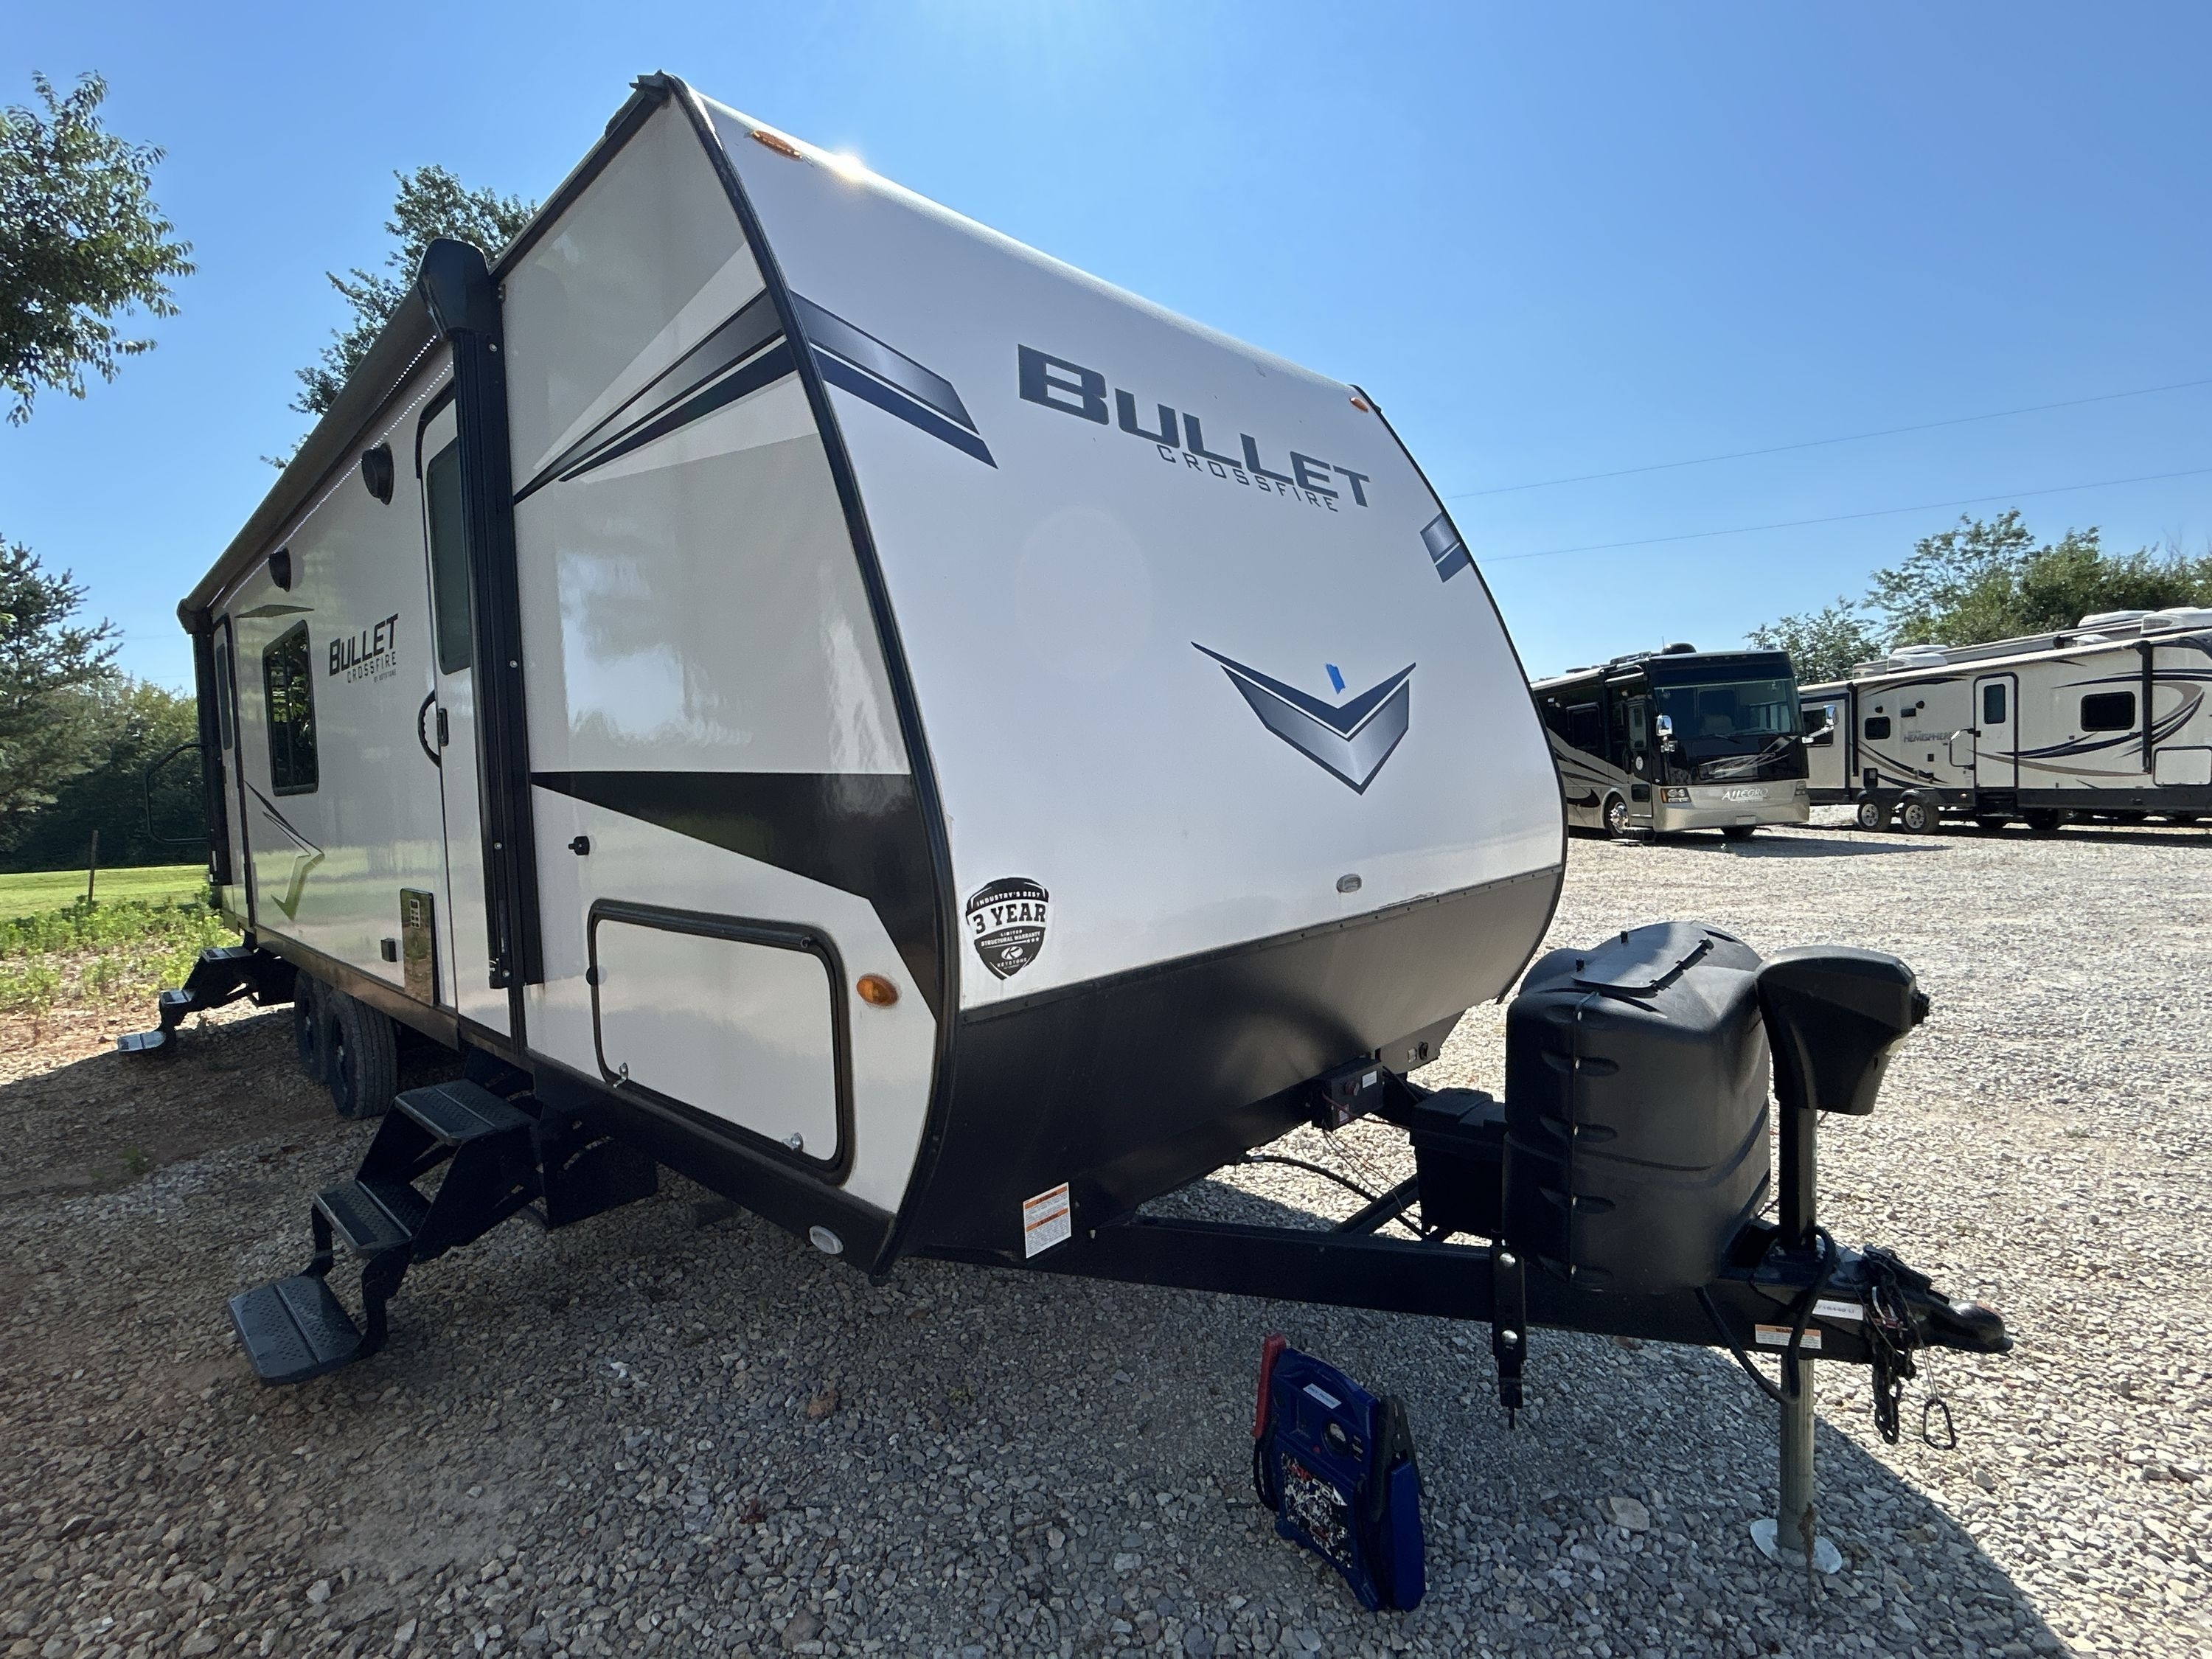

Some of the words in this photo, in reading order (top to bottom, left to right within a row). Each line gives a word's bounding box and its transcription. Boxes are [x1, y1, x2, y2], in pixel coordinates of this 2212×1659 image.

[1018, 344, 1371, 508] BULLET
[1155, 444, 1339, 512] CROSSFIRE
[329, 612, 399, 677] BULLET
[347, 650, 397, 684] CROSSFIRE
[976, 891, 1020, 907] INDUSTRY'S
[973, 913, 987, 935] 3
[990, 902, 1046, 926] YEAR
[981, 936, 1014, 947] STRUCTURAL
[1014, 931, 1041, 942] WARRANTY
[996, 957, 1027, 967] KEYSTONE
